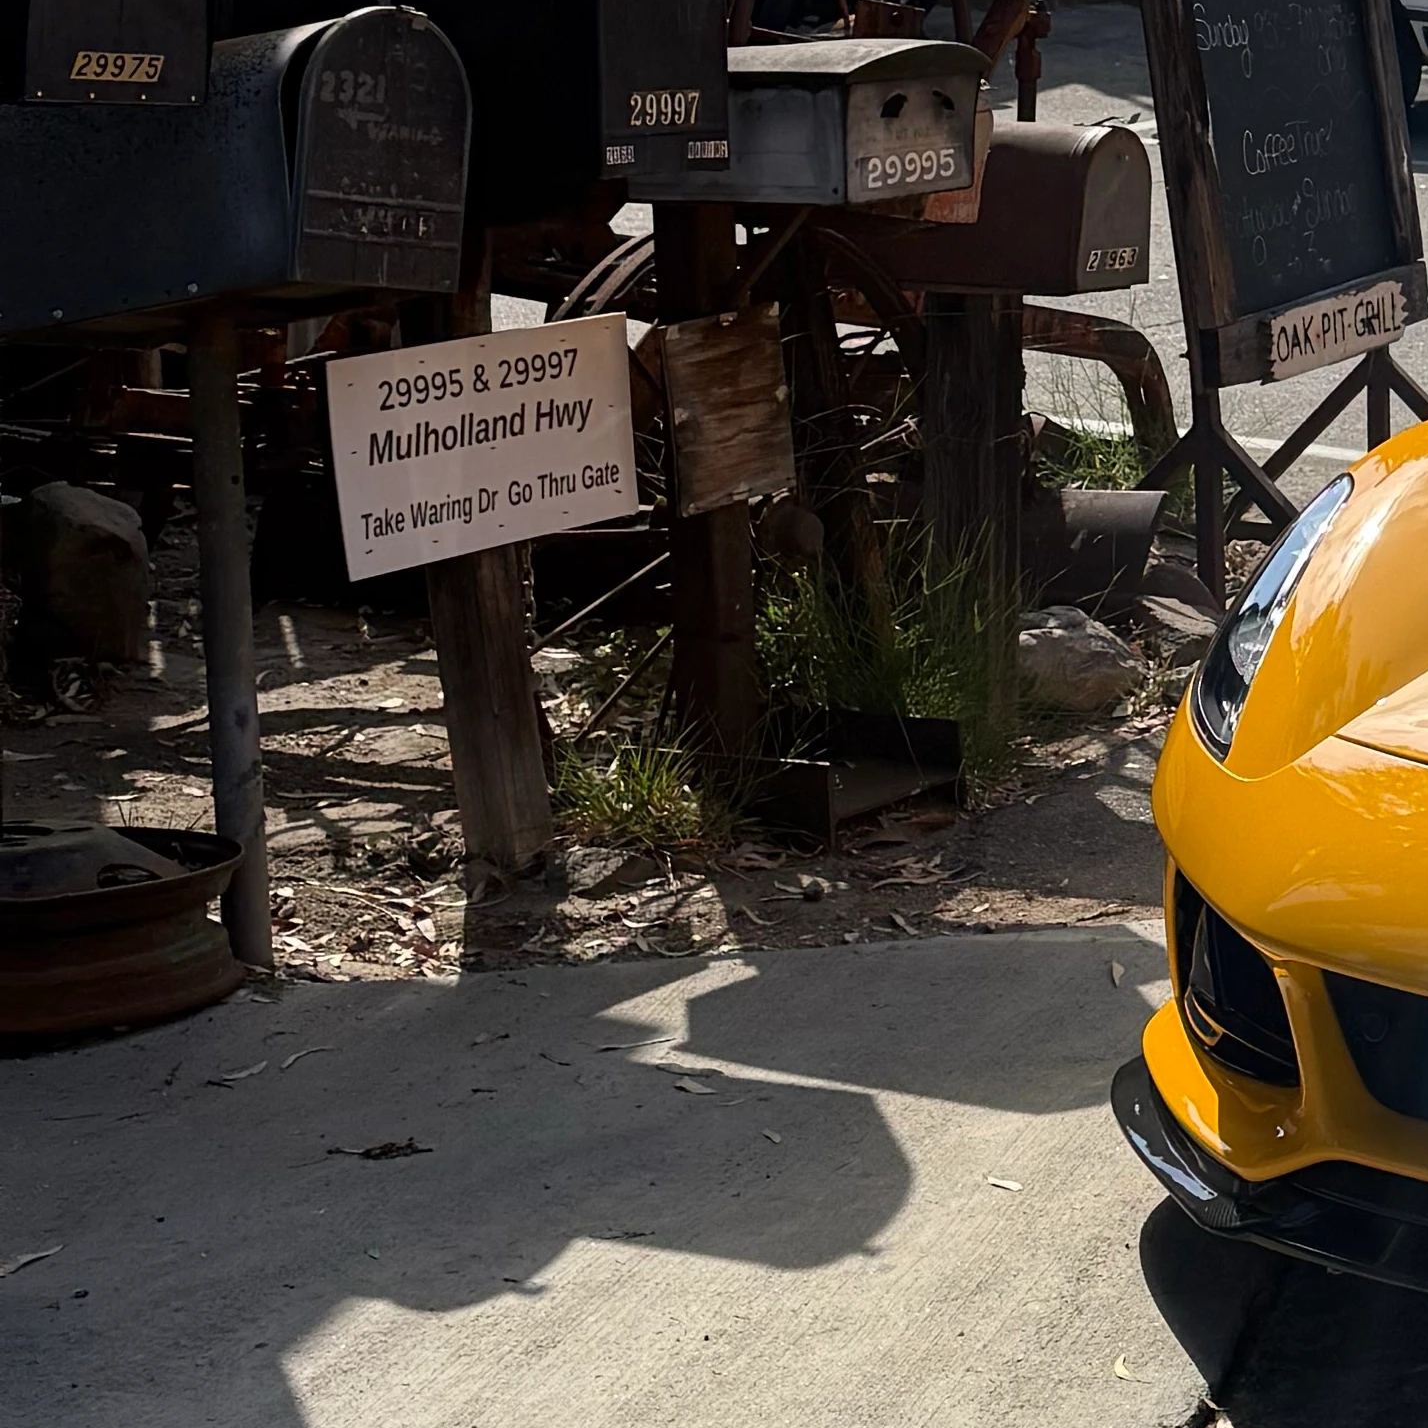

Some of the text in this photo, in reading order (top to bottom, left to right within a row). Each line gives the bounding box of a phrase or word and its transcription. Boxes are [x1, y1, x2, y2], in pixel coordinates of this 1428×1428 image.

[75, 53, 160, 79] 29975
[319, 69, 387, 104] 2321
[629, 91, 699, 126] 29997
[867, 147, 955, 189] 29995
[1242, 129, 1299, 176] Coffee
[378, 348, 579, 412] 29995 & 29997
[368, 398, 594, 467] Mulholland Hwy
[361, 460, 620, 540] Take Waring Dr Go Thru Gate
